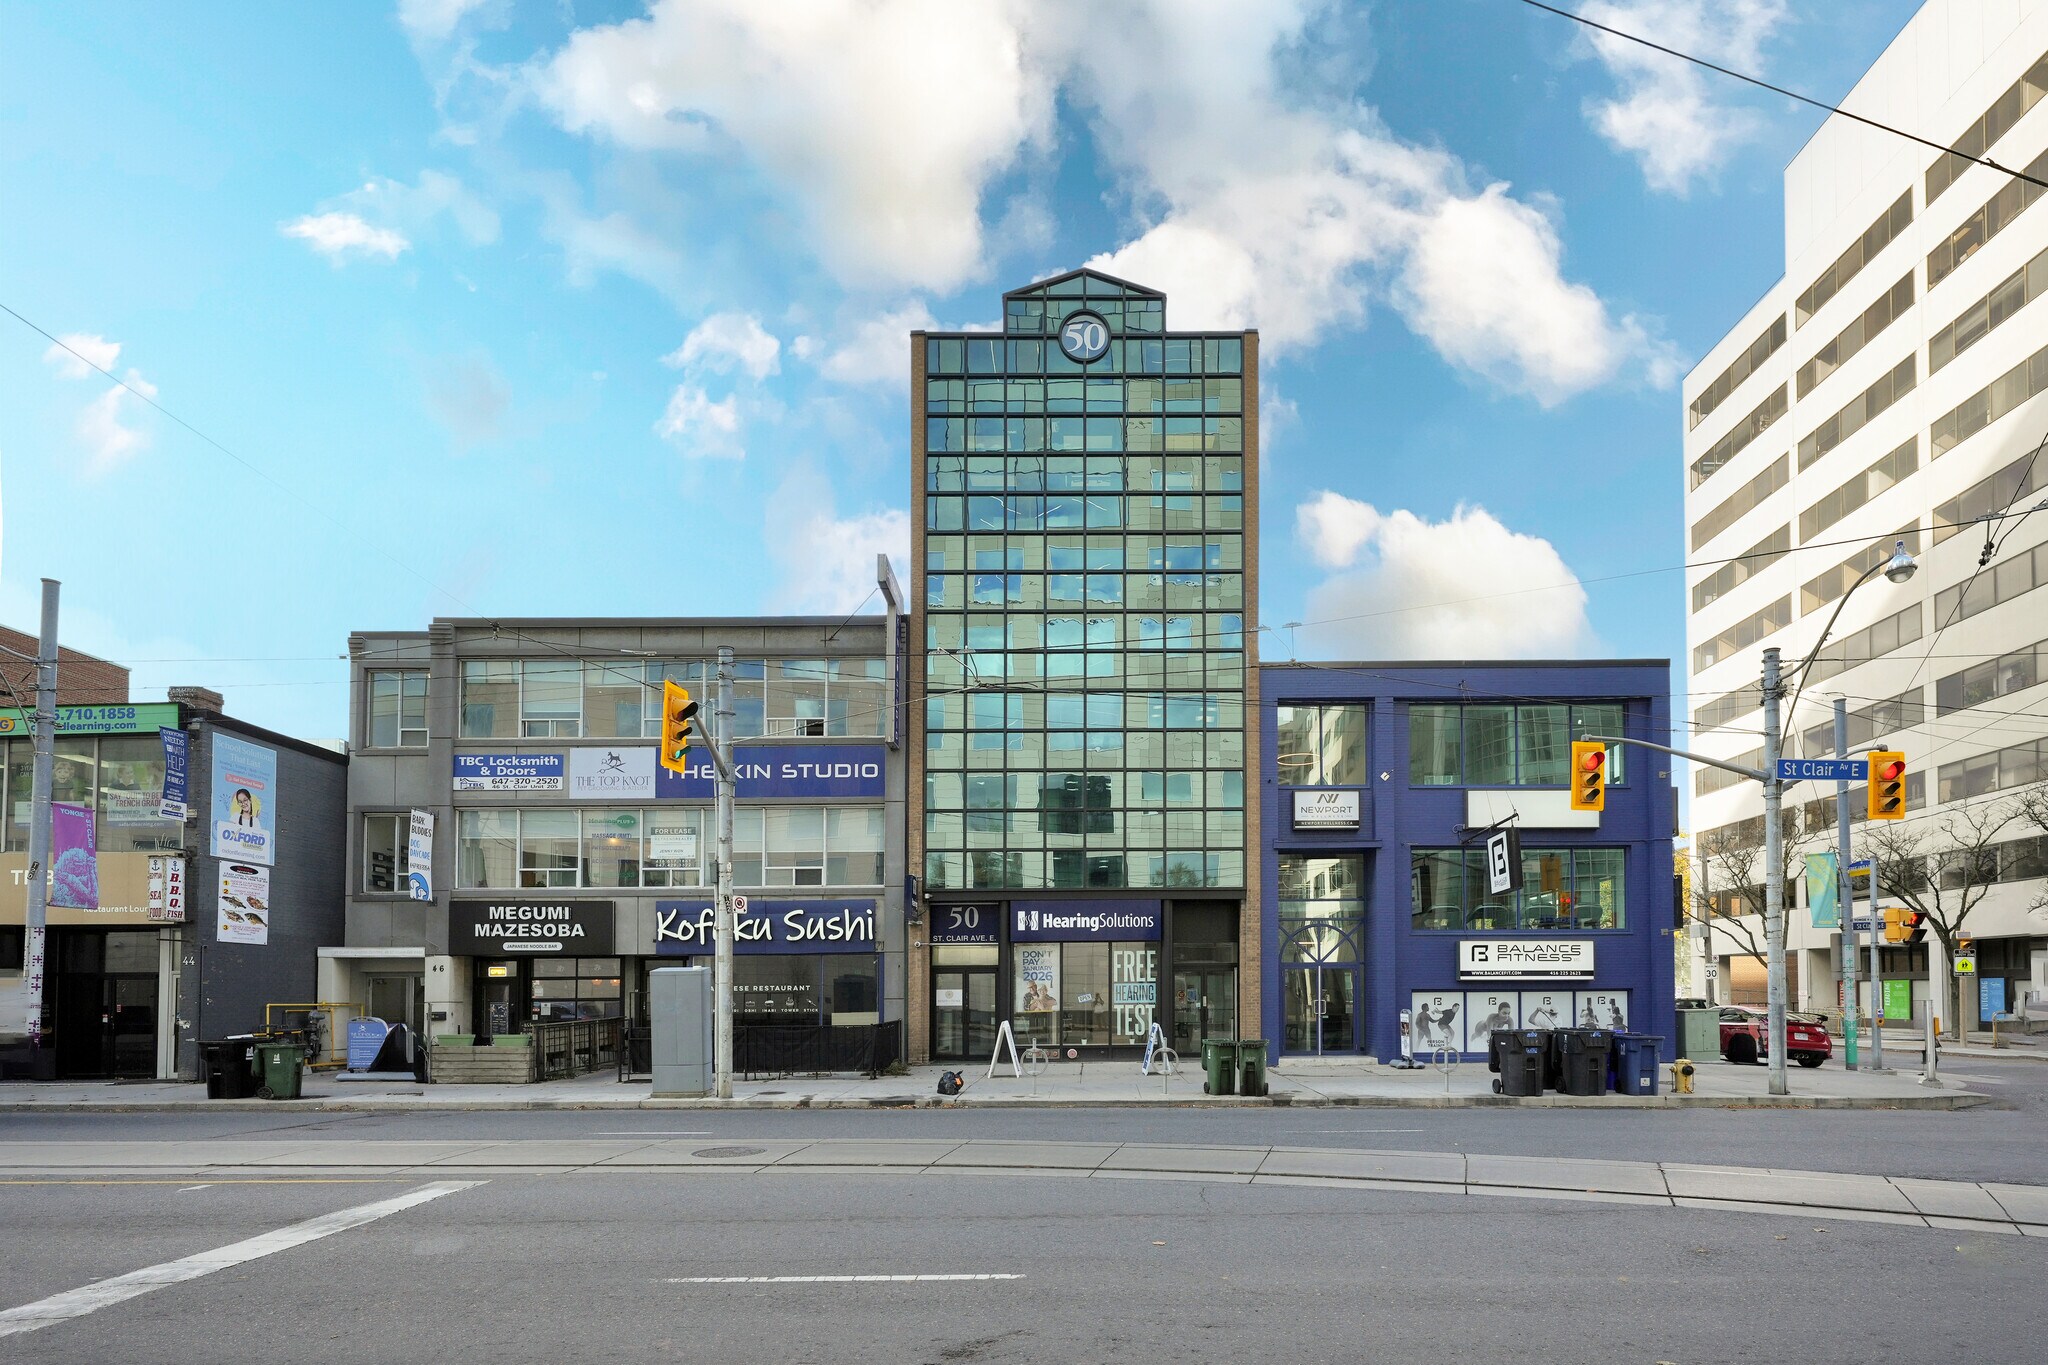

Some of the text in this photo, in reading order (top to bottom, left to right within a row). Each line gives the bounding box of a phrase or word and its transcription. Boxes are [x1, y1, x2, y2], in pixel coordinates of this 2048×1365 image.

[1066, 323, 1105, 352] 50
[54, 707, 136, 720] 6.710.1858
[164, 736, 184, 746] NEEDS
[167, 754, 185, 771] HELP
[459, 756, 559, 766] TBC Locksmith
[480, 767, 537, 775] & Doors
[734, 764, 771, 779] KIN
[781, 763, 879, 778] STUDIO
[1784, 762, 1797, 776] St
[1802, 762, 1834, 776] Clair
[1851, 763, 1859, 776] E
[491, 777, 559, 785] 647-370-2520
[576, 776, 651, 786] THE TOP KNOT
[116, 800, 141, 808] FRENCH
[60, 808, 84, 817] YONGE
[412, 814, 426, 825] BARK
[411, 825, 432, 837] BUDDIES
[222, 829, 266, 846] OXFORD
[410, 838, 421, 848] DOG
[410, 848, 430, 860] DAYCARE
[150, 891, 162, 900] SEA
[150, 908, 162, 918] FOOD
[167, 910, 183, 918] FISH
[489, 906, 570, 920] MEGUMI
[948, 906, 979, 929] 50
[657, 908, 874, 945] Kofku Sushi
[1043, 912, 1154, 931] HearingSolutions
[474, 923, 585, 937] MAZESOBA
[1022, 950, 1053, 958] DON'T
[1497, 944, 1581, 955] BALANCE
[182, 956, 195, 965] 44
[1022, 958, 1040, 966] PAY
[1497, 953, 1572, 961] FITNESS
[1113, 950, 1156, 982] FREE
[1023, 971, 1053, 981] 2026
[1706, 969, 1718, 977] 30
[1115, 984, 1154, 1000] HEARING
[1113, 1004, 1156, 1036] TEST
